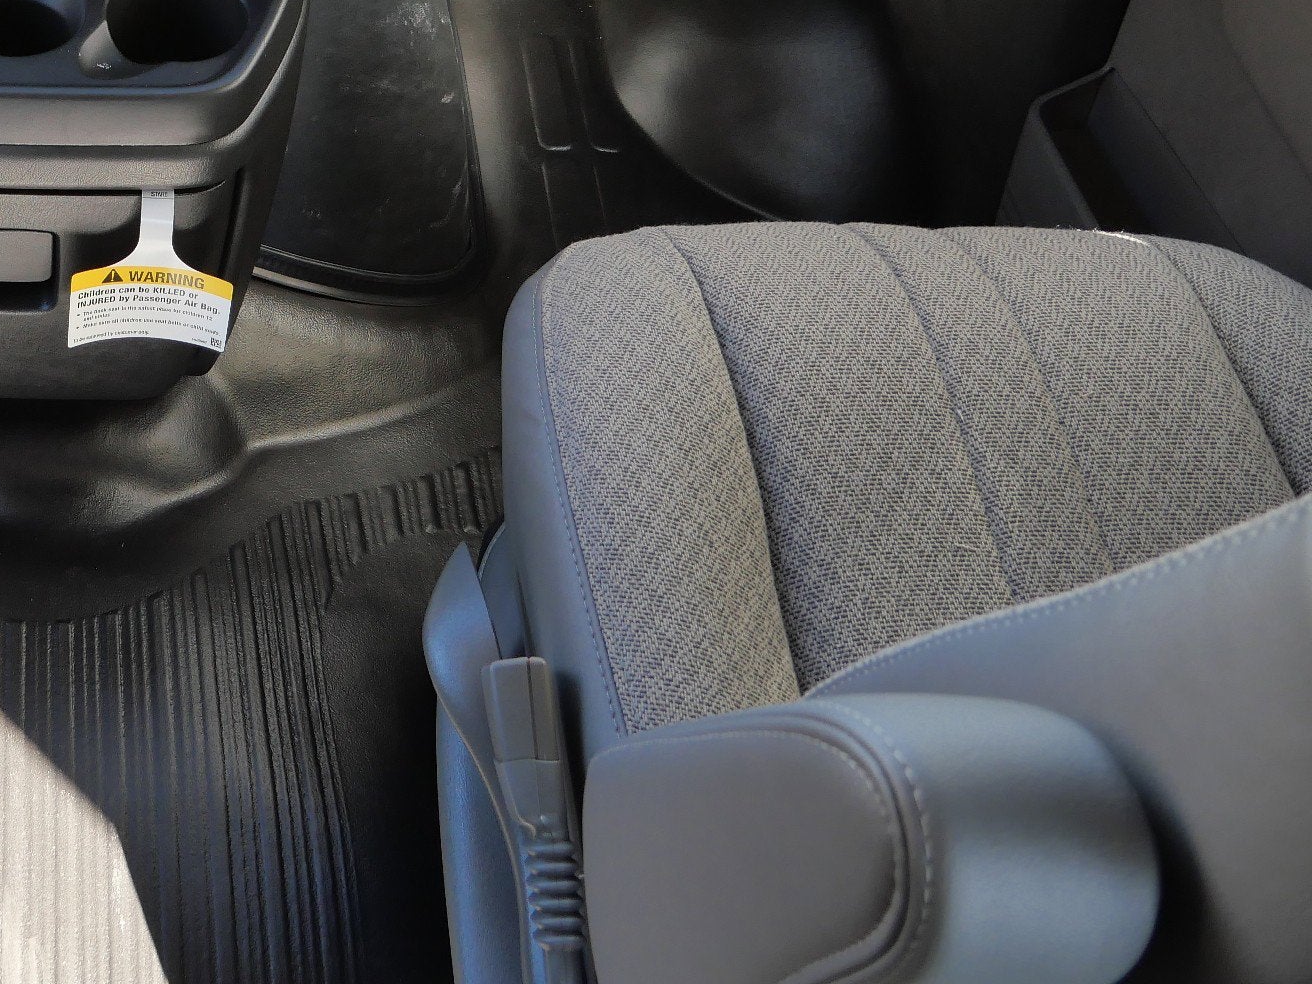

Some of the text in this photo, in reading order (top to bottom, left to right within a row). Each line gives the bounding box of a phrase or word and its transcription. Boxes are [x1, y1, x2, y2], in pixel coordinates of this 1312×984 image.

[129, 270, 205, 290] WARNING
[78, 287, 116, 300] Children
[138, 286, 150, 294] be
[153, 286, 186, 297] KILLED
[188, 291, 199, 300] or
[77, 294, 221, 315] INJURED by Passenger Air Bag.
